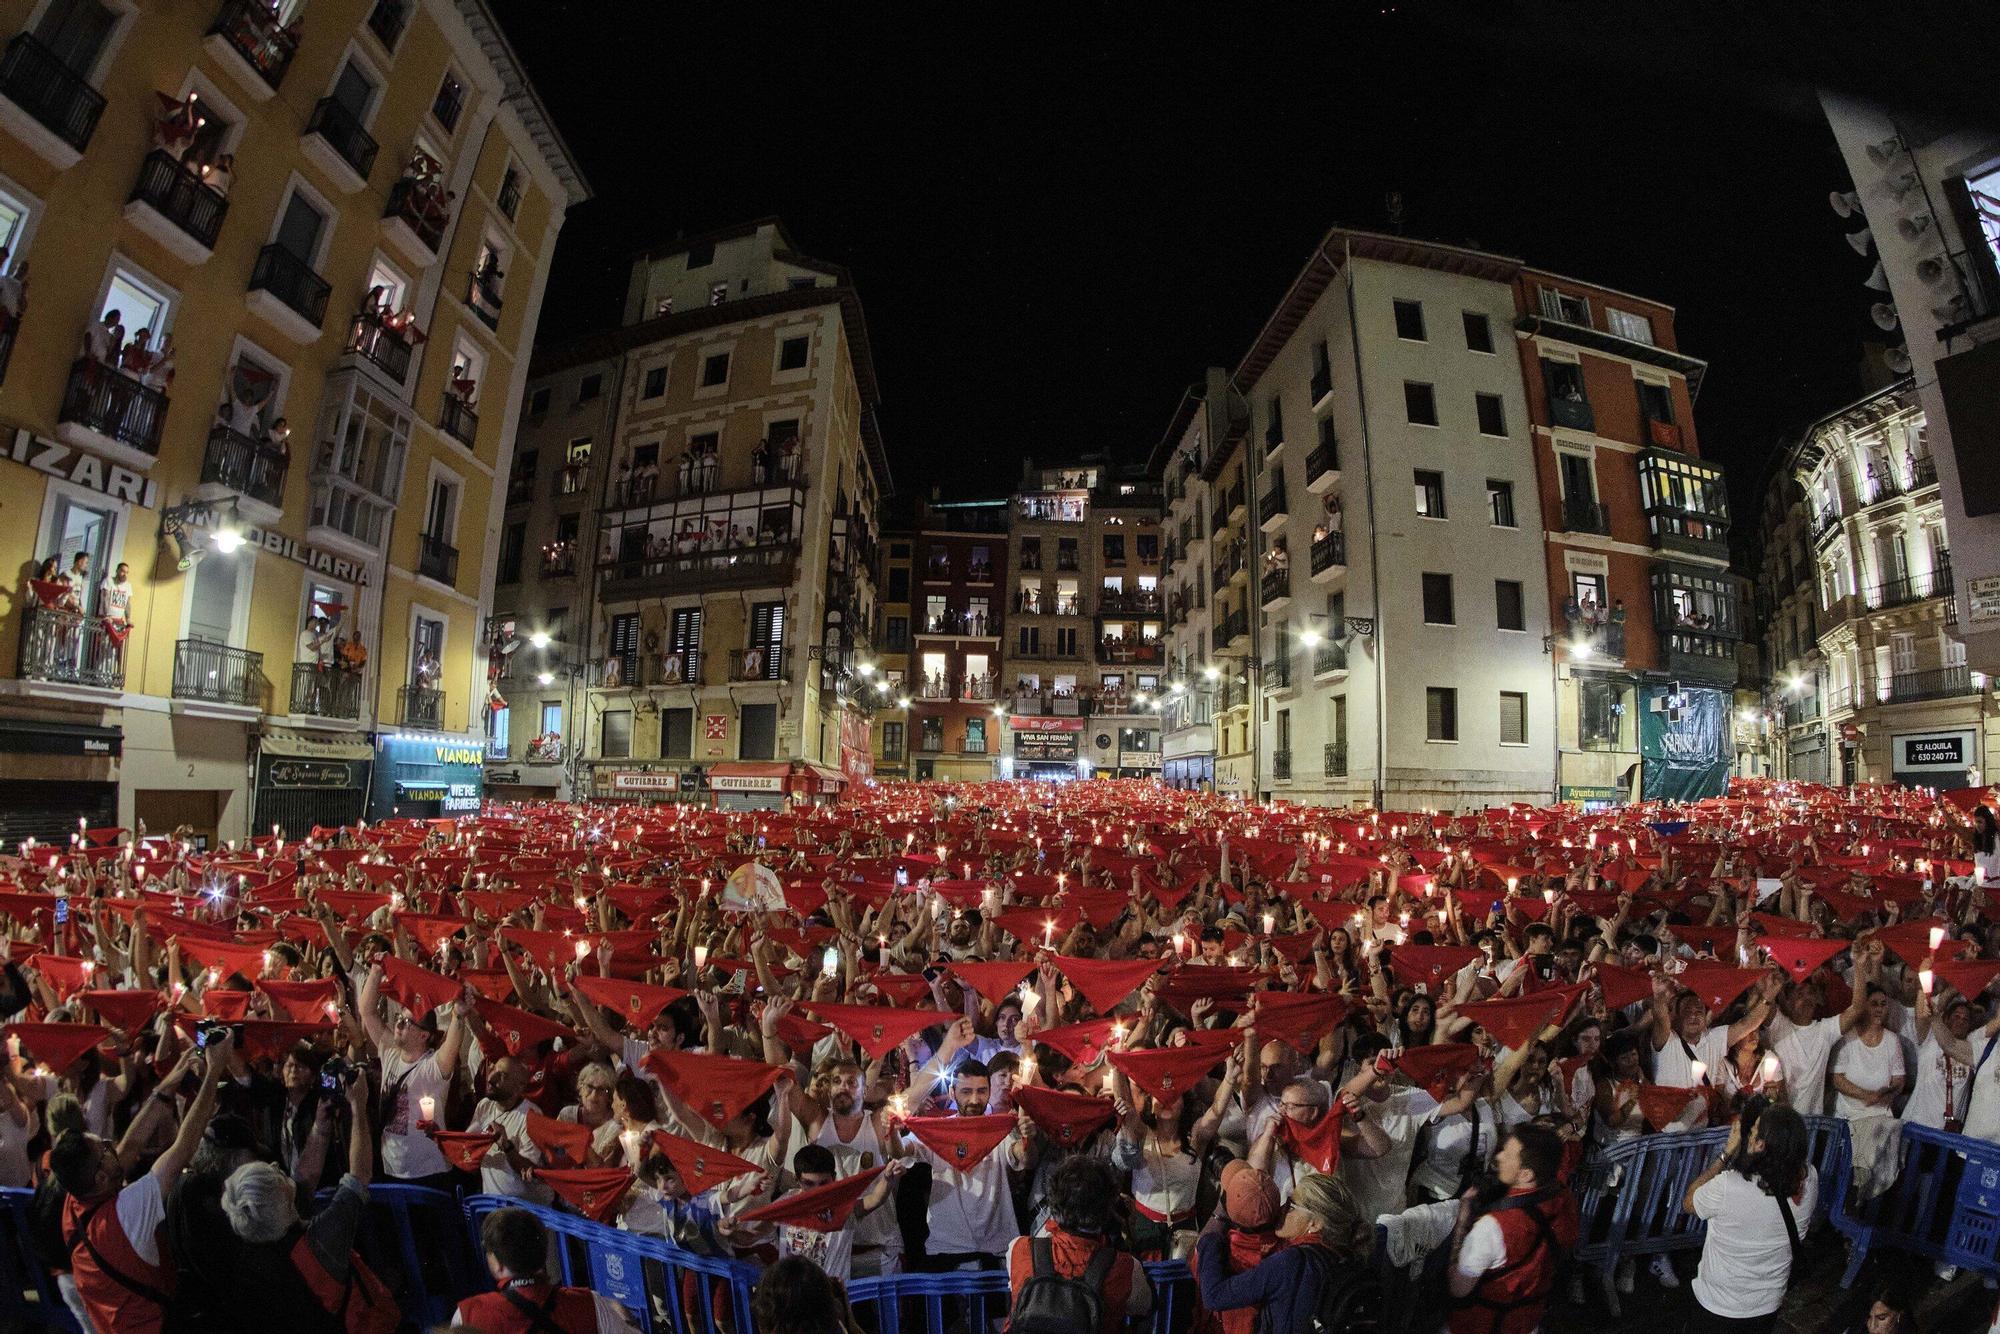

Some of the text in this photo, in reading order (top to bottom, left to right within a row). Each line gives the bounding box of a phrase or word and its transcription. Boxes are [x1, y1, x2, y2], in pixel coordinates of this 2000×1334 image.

[0, 428, 157, 508] IZARI
[186, 508, 370, 585] INOBILIARIA
[1915, 742, 1952, 751] SE ALQUILA
[436, 746, 482, 764] VIANDAS
[1918, 752, 1958, 762] 630 240 771
[187, 764, 195, 778] 2
[623, 777, 668, 787] GUTIERREZ
[721, 777, 772, 789] GUTIERREZ
[409, 789, 444, 801] VIANDAS
[445, 797, 481, 811] FARMERS
